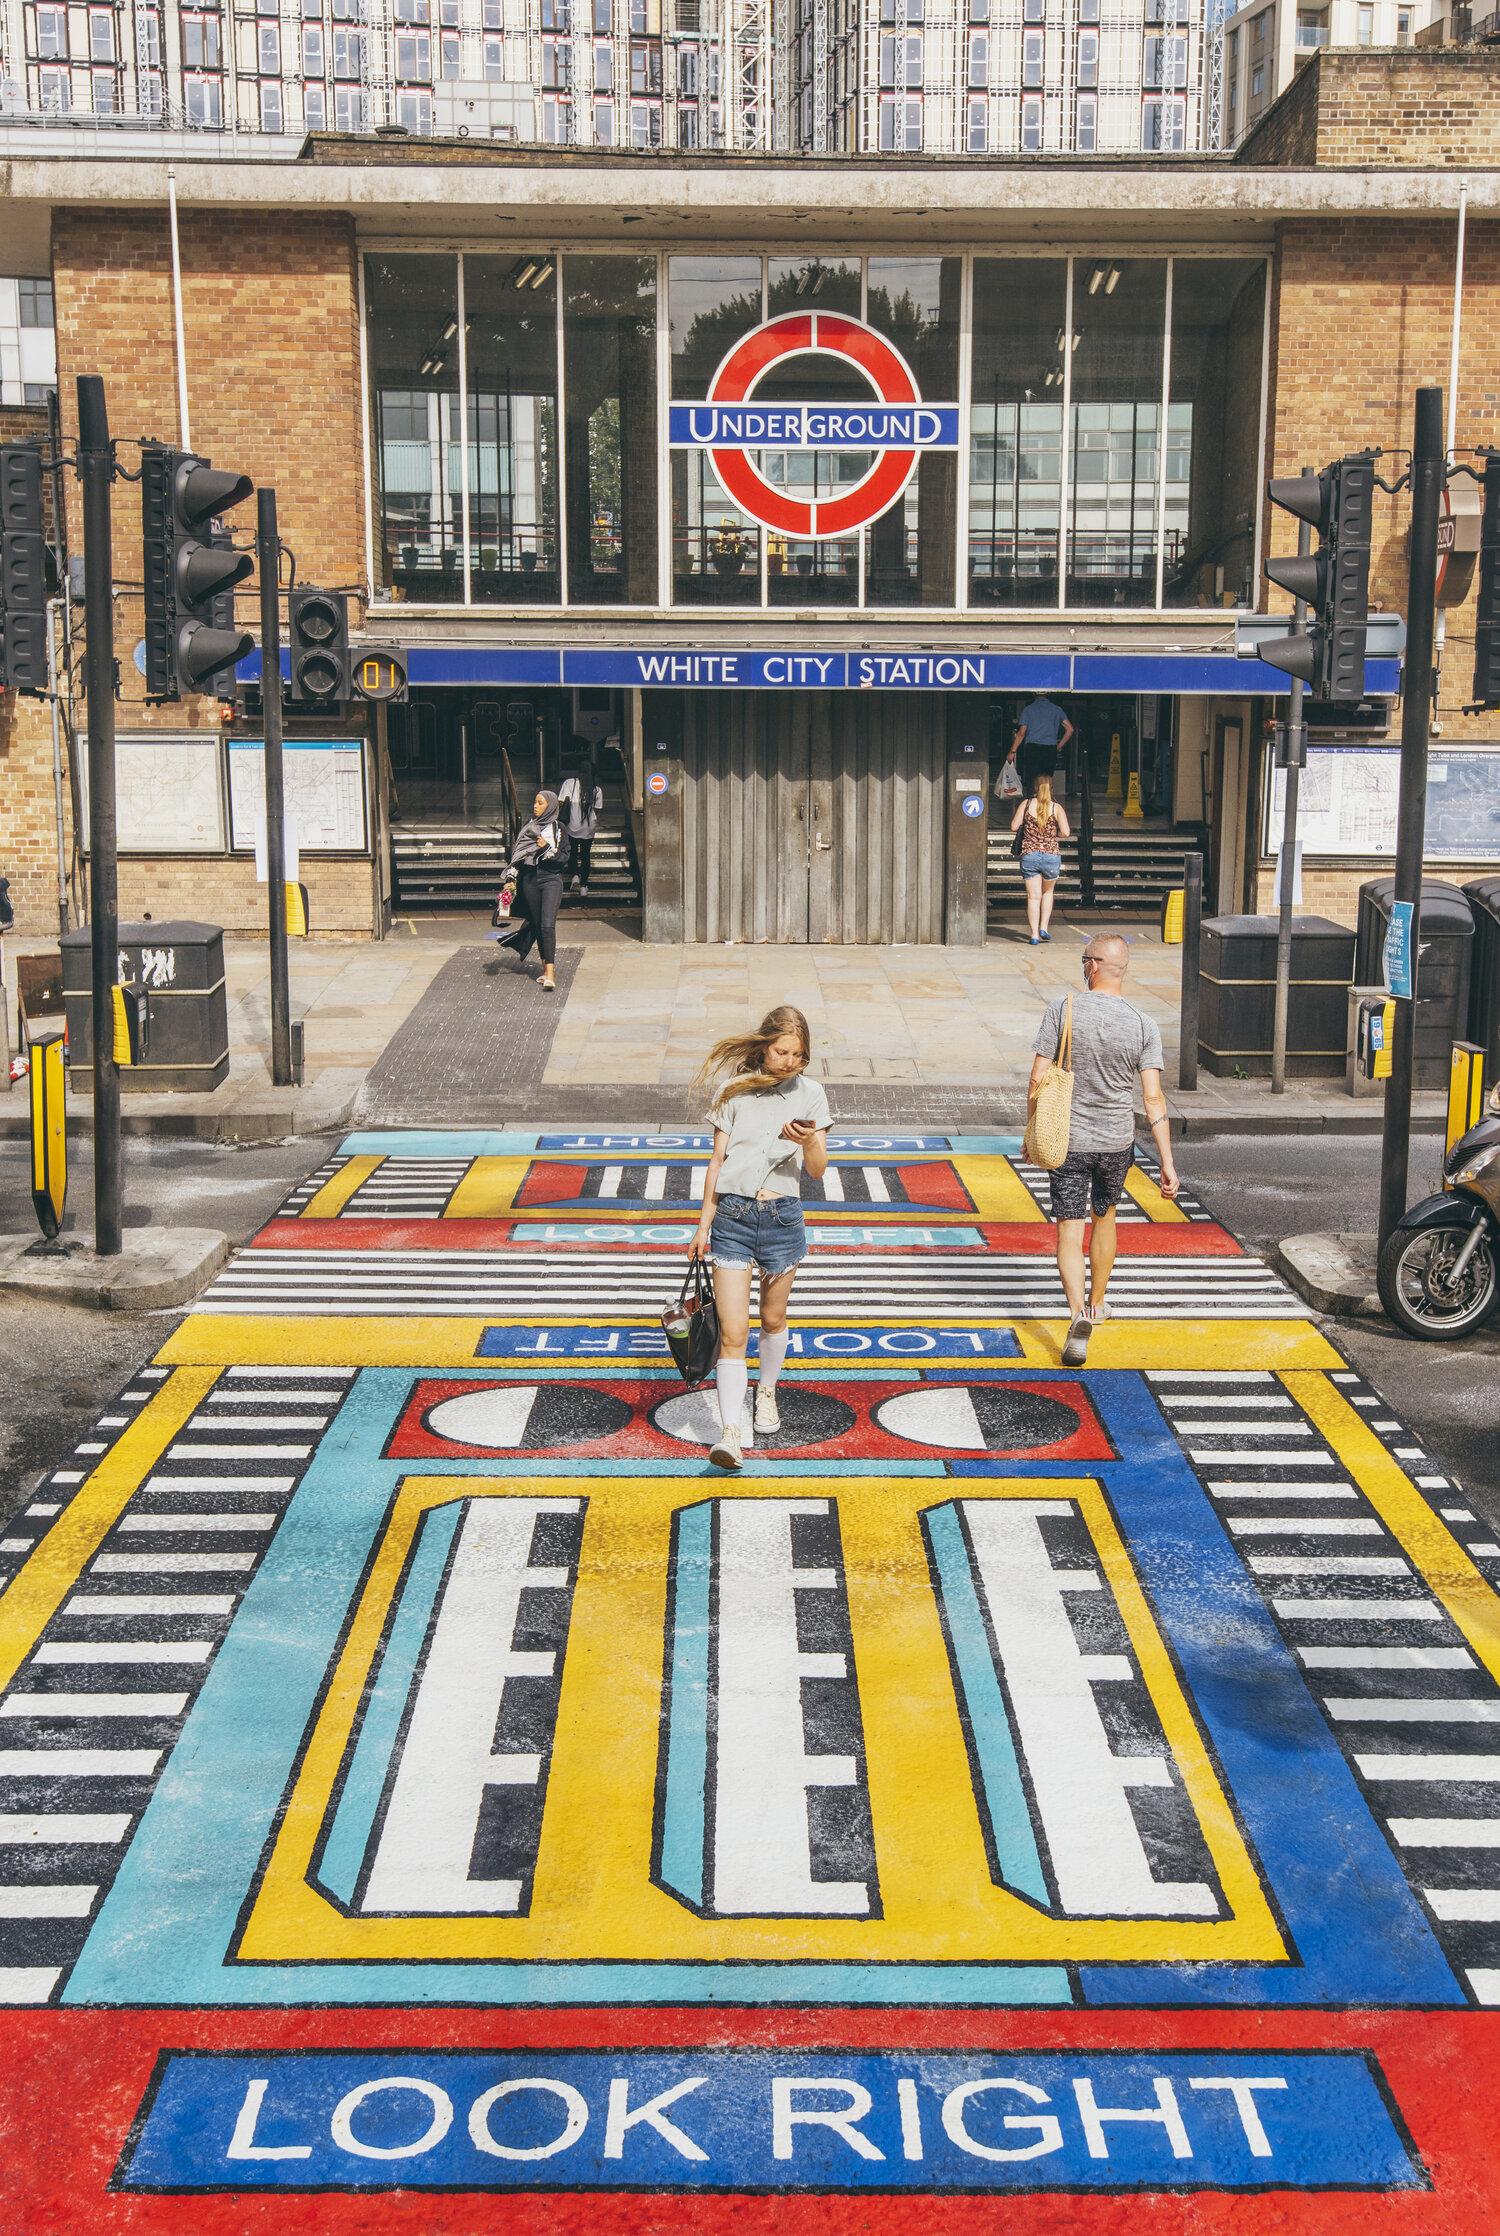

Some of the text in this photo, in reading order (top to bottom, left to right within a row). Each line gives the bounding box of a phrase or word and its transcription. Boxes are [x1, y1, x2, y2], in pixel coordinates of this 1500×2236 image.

[689, 408, 942, 443] UNDERGROUND
[364, 661, 395, 689] 01
[637, 656, 985, 684] WHITE CITY STATION
[563, 1137, 715, 1148] IGHT
[544, 1226, 947, 1243] LOO EFT
[514, 1332, 671, 1352] EFT
[226, 2076, 1289, 2162] LOOK RIGHT
